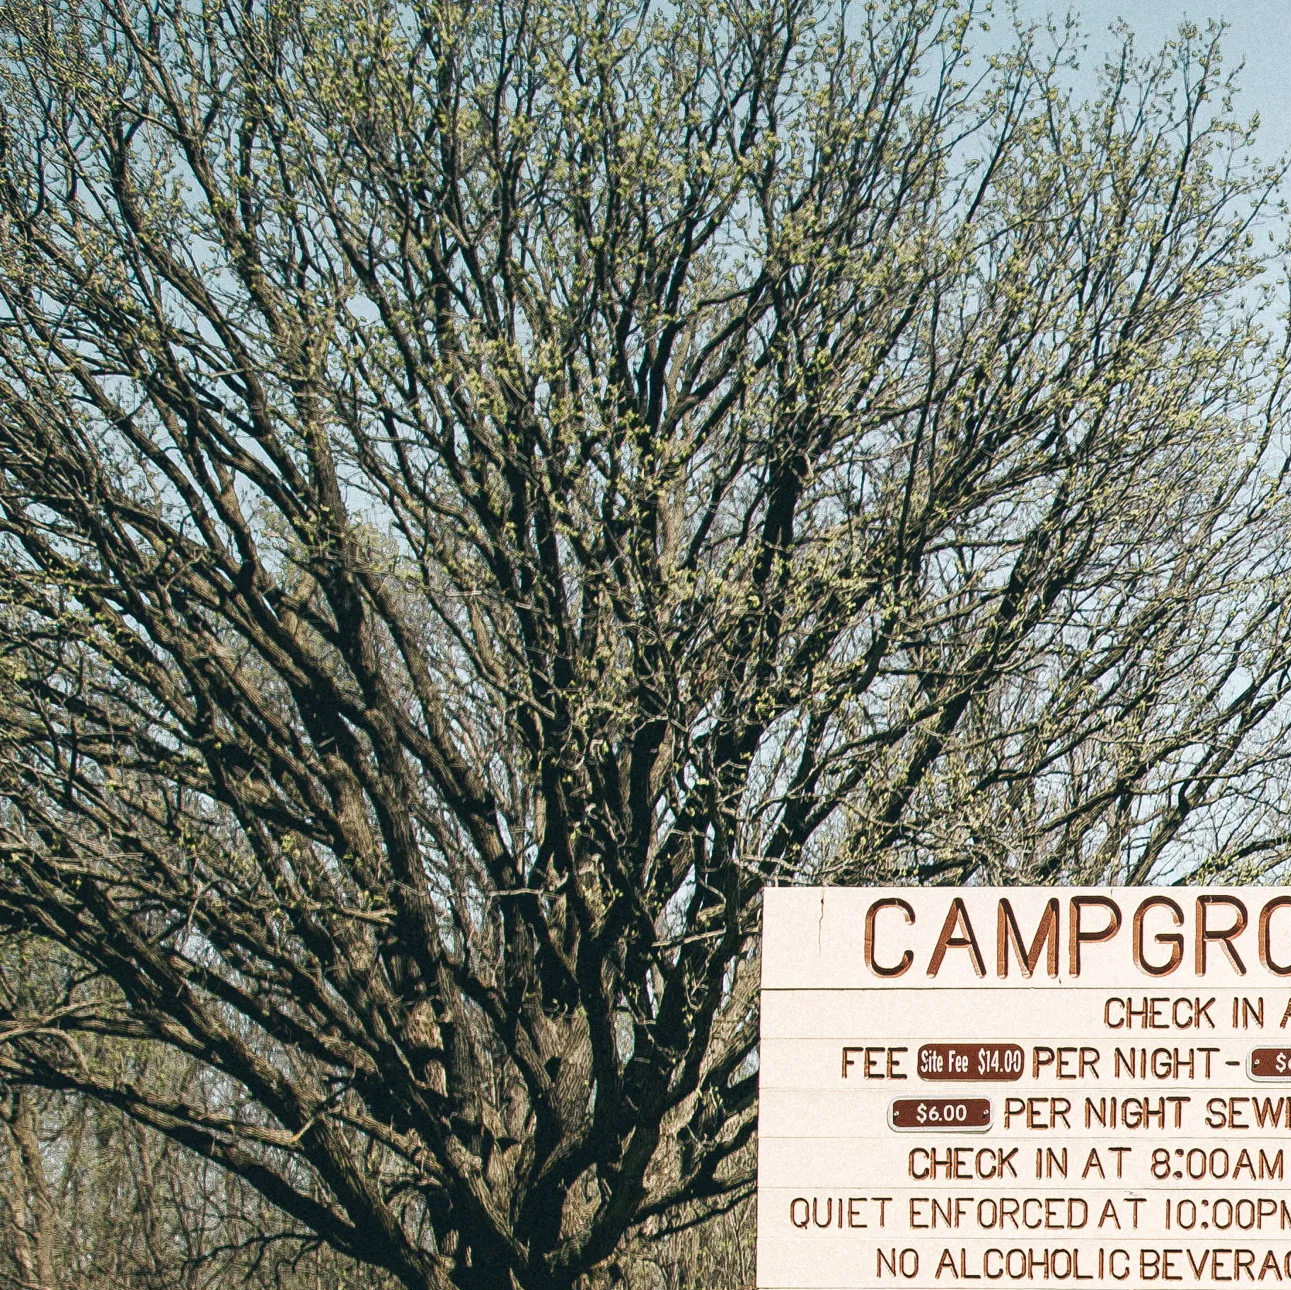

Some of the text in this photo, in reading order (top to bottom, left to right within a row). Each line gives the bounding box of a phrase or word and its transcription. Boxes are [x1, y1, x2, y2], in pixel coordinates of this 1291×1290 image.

[1103, 996, 1216, 1030] CHECK
[1232, 996, 1264, 1030] IN
[841, 1046, 909, 1080] FEE
[920, 1049, 944, 1073] Site
[948, 1049, 969, 1073] Fee
[977, 1048, 1022, 1075] $14.00
[1032, 1045, 1101, 1080] PER
[916, 1102, 967, 1124] $6.00
[1003, 1096, 1072, 1130] PER
[1084, 1096, 1192, 1130] NIGHT
[908, 1147, 1019, 1180] CHECK
[1035, 1147, 1068, 1180] IN
[1081, 1146, 1133, 1179] AT
[1150, 1147, 1284, 1181] 8:00AM
[789, 1196, 893, 1230] QUIET
[909, 1197, 1089, 1230] ENFORCED
[1097, 1197, 1148, 1230] AT
[876, 1247, 919, 1279] NO
[934, 1247, 1130, 1281] ALCOHOLIC
